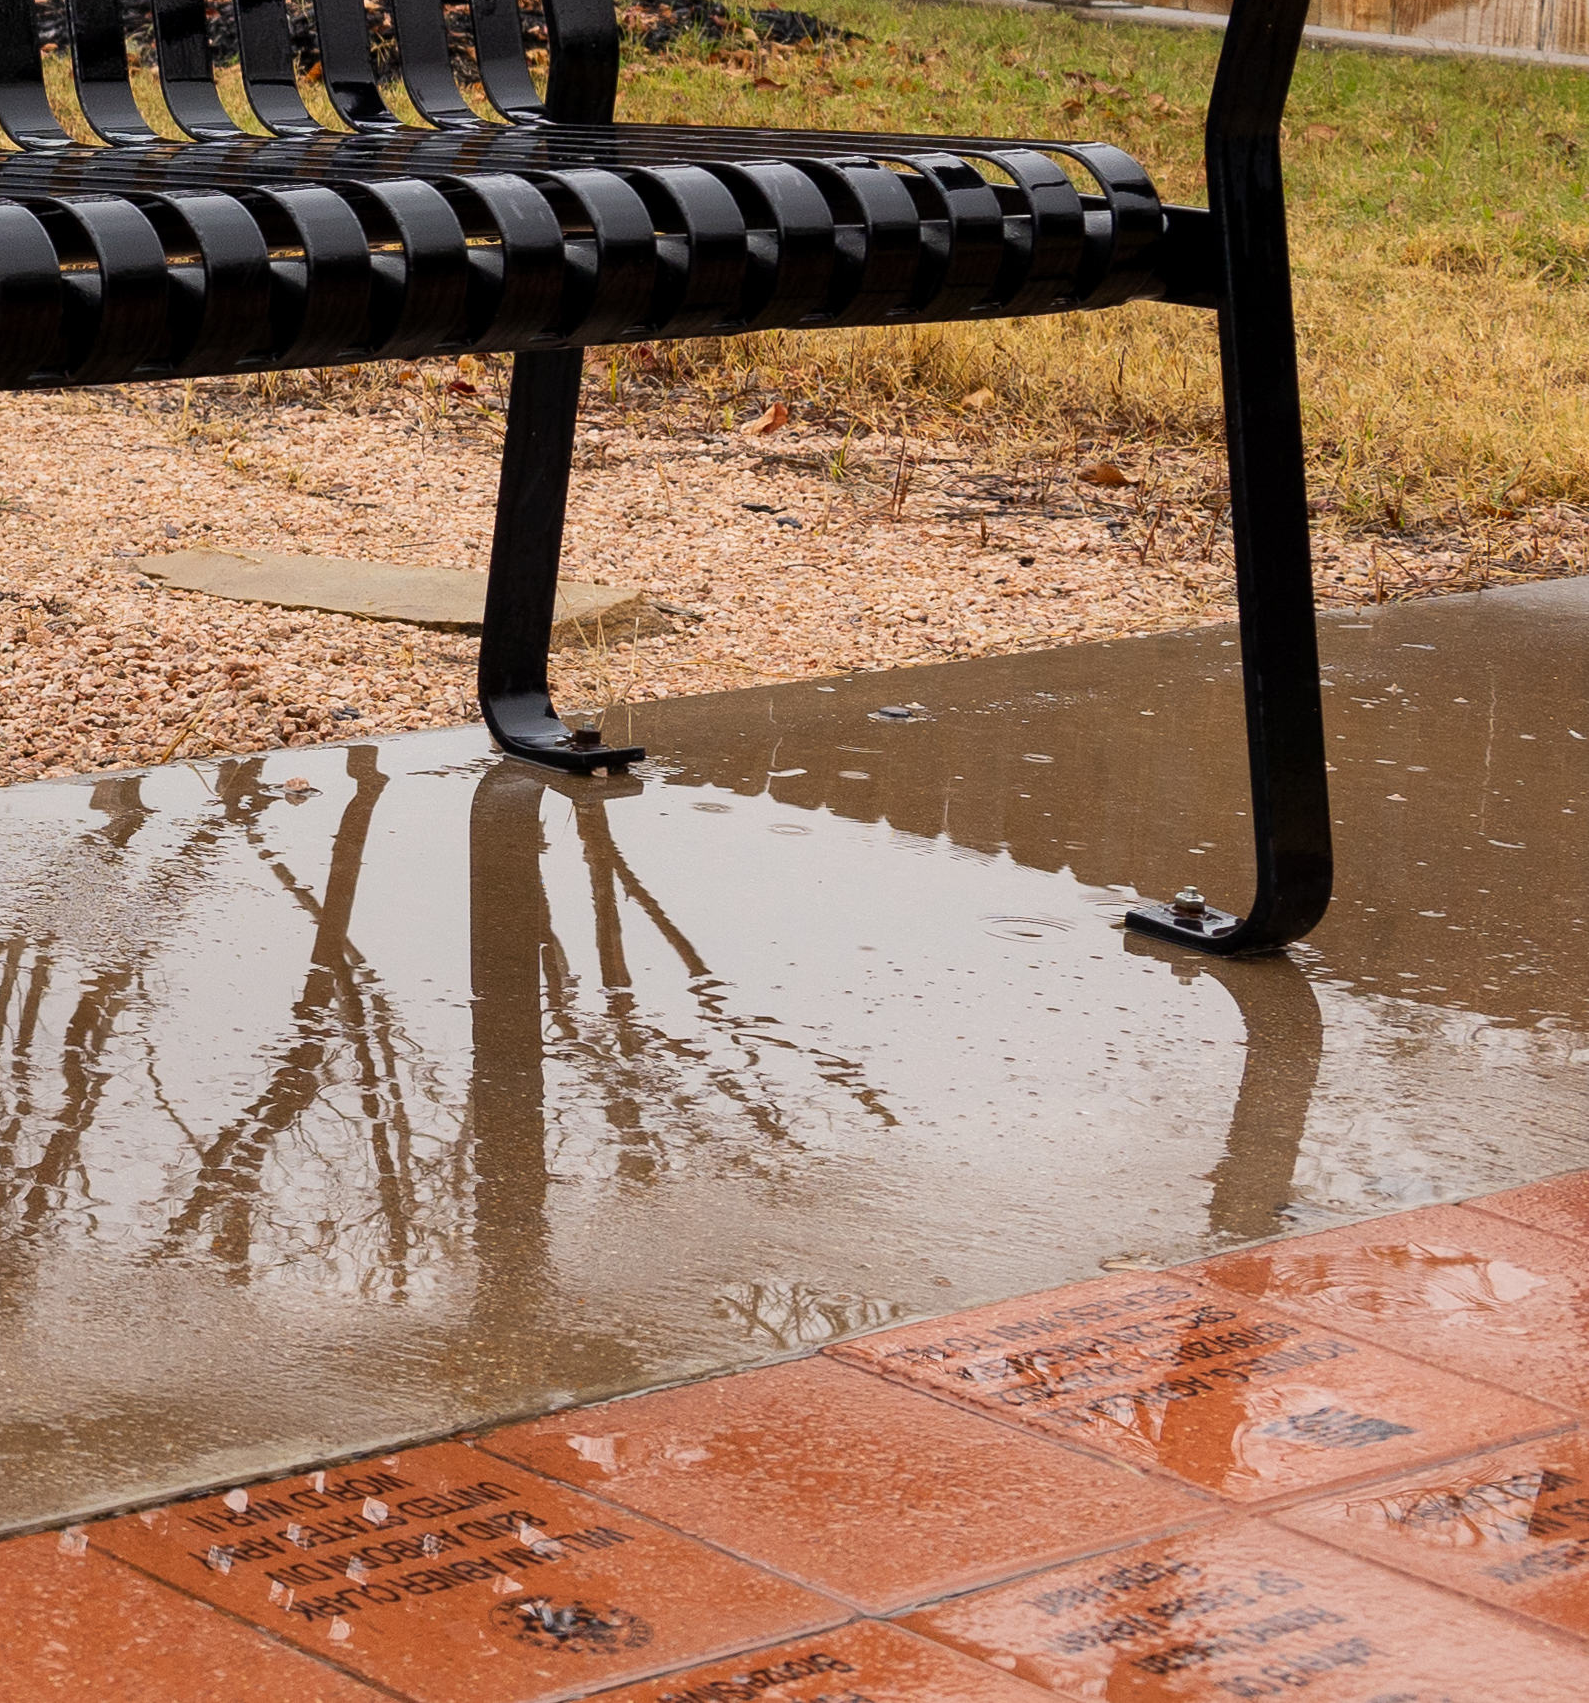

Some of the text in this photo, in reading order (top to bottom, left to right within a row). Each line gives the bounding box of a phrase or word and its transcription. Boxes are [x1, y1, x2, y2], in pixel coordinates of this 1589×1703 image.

[1050, 1285, 1196, 1324] SELFLESS
[1163, 1306, 1238, 1327] SPC
[936, 1334, 997, 1353] TO
[986, 1317, 1064, 1340] MAN
[1233, 1340, 1361, 1374] RONNIE
[190, 1471, 411, 1532] WORLD WAR II
[394, 1481, 518, 1519] UNITED
[275, 1507, 409, 1549] STATES
[264, 1563, 332, 1588] DIV
[388, 1556, 509, 1595] ABNER
[281, 1582, 405, 1622] CLARK
